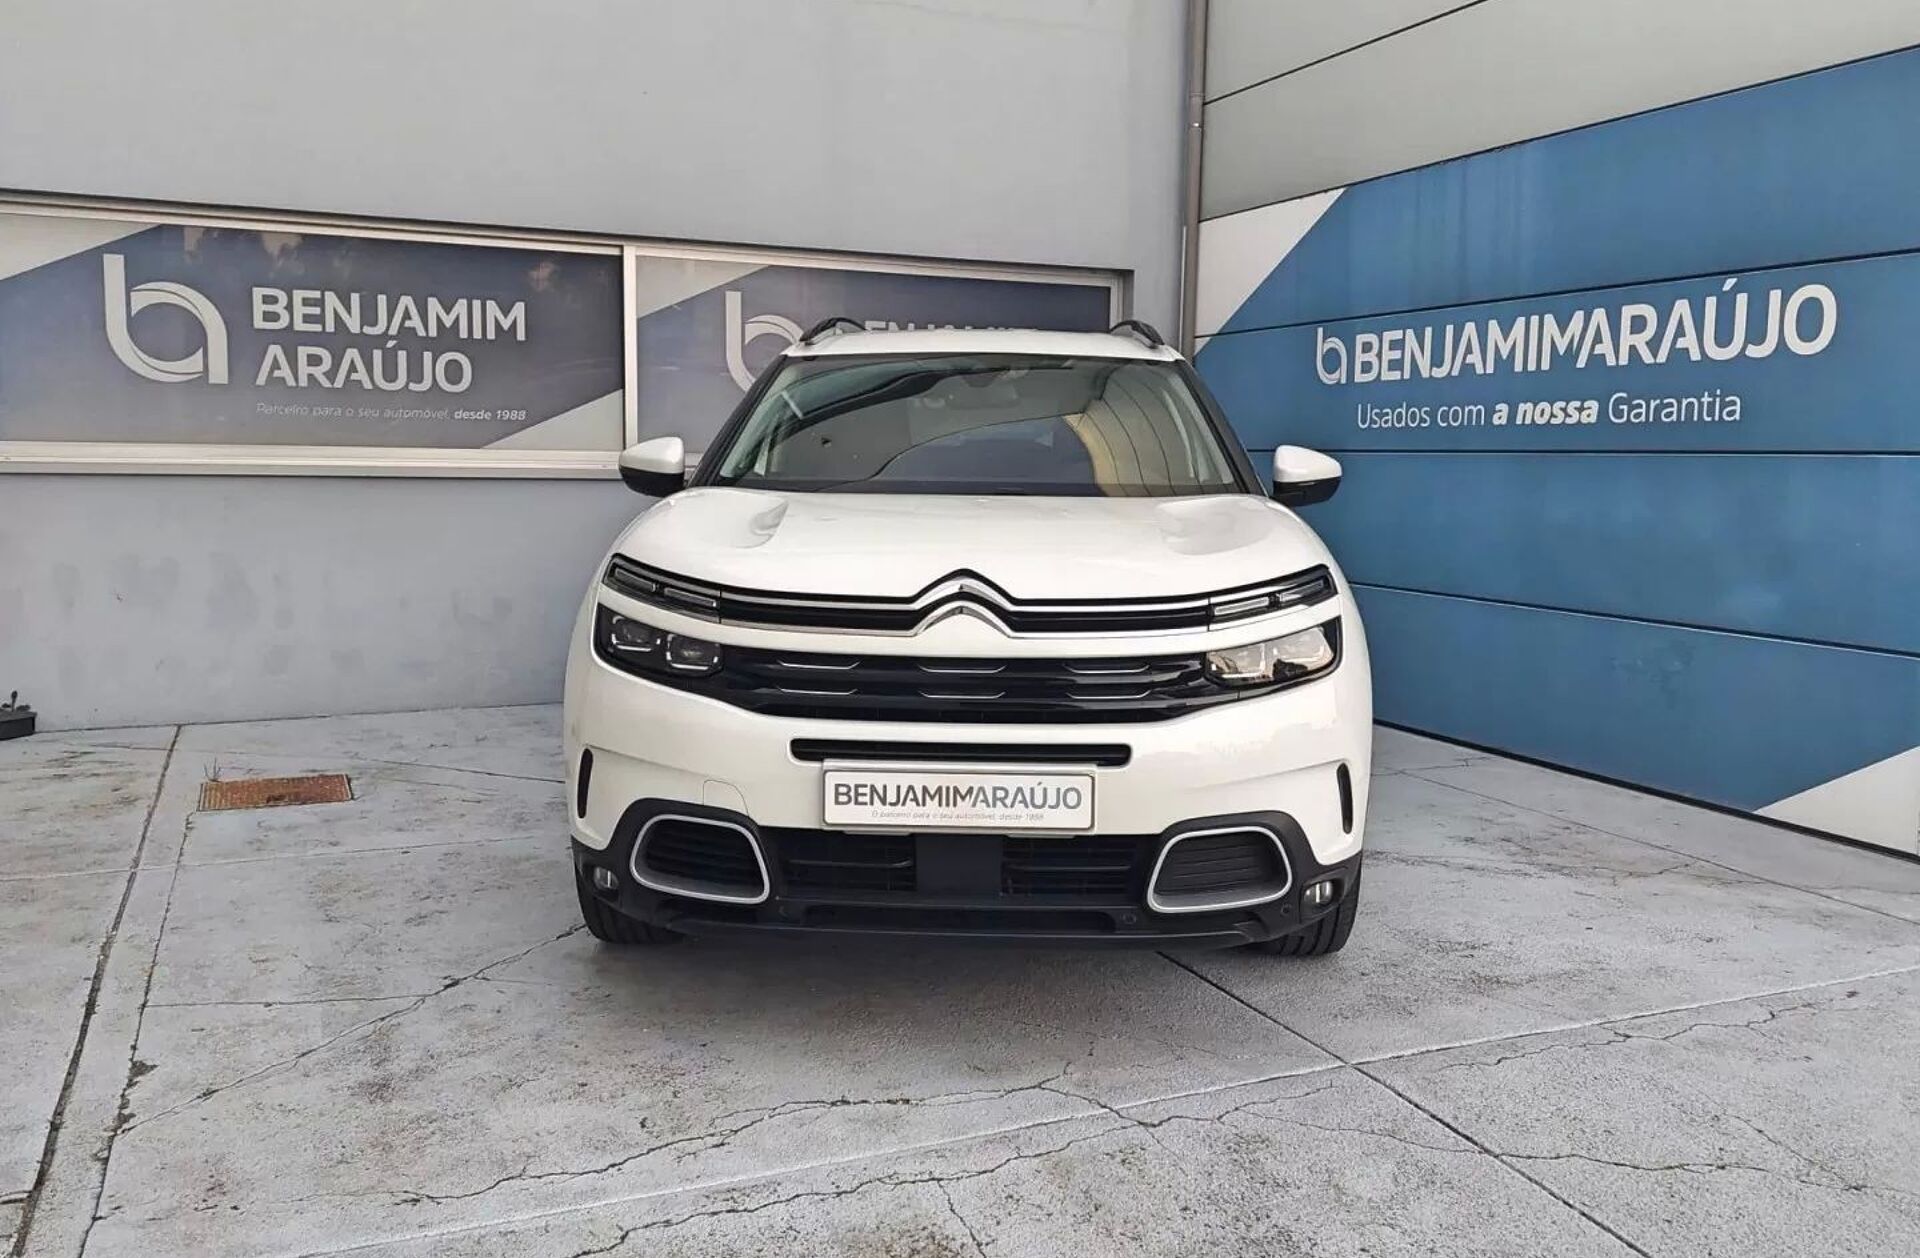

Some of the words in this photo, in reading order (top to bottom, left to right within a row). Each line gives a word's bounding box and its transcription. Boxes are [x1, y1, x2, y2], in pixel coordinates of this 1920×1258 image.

[251, 287, 527, 341] BENJAMIM
[1354, 278, 1837, 384] BENJAMIMARAÚJO
[255, 340, 473, 393] ARAÚJO
[256, 402, 309, 417] Parceiro
[312, 406, 342, 420] para
[345, 408, 354, 417] o
[358, 407, 380, 418] seu
[454, 409, 491, 420] desde
[496, 409, 526, 420] 1988
[1357, 402, 1430, 429] Usados
[1437, 403, 1485, 428] com
[1492, 403, 1508, 426] a
[1515, 401, 1599, 425] nossa
[1608, 389, 1742, 424] Garantia
[834, 782, 1082, 810] BENJAMIMARAÚJO
